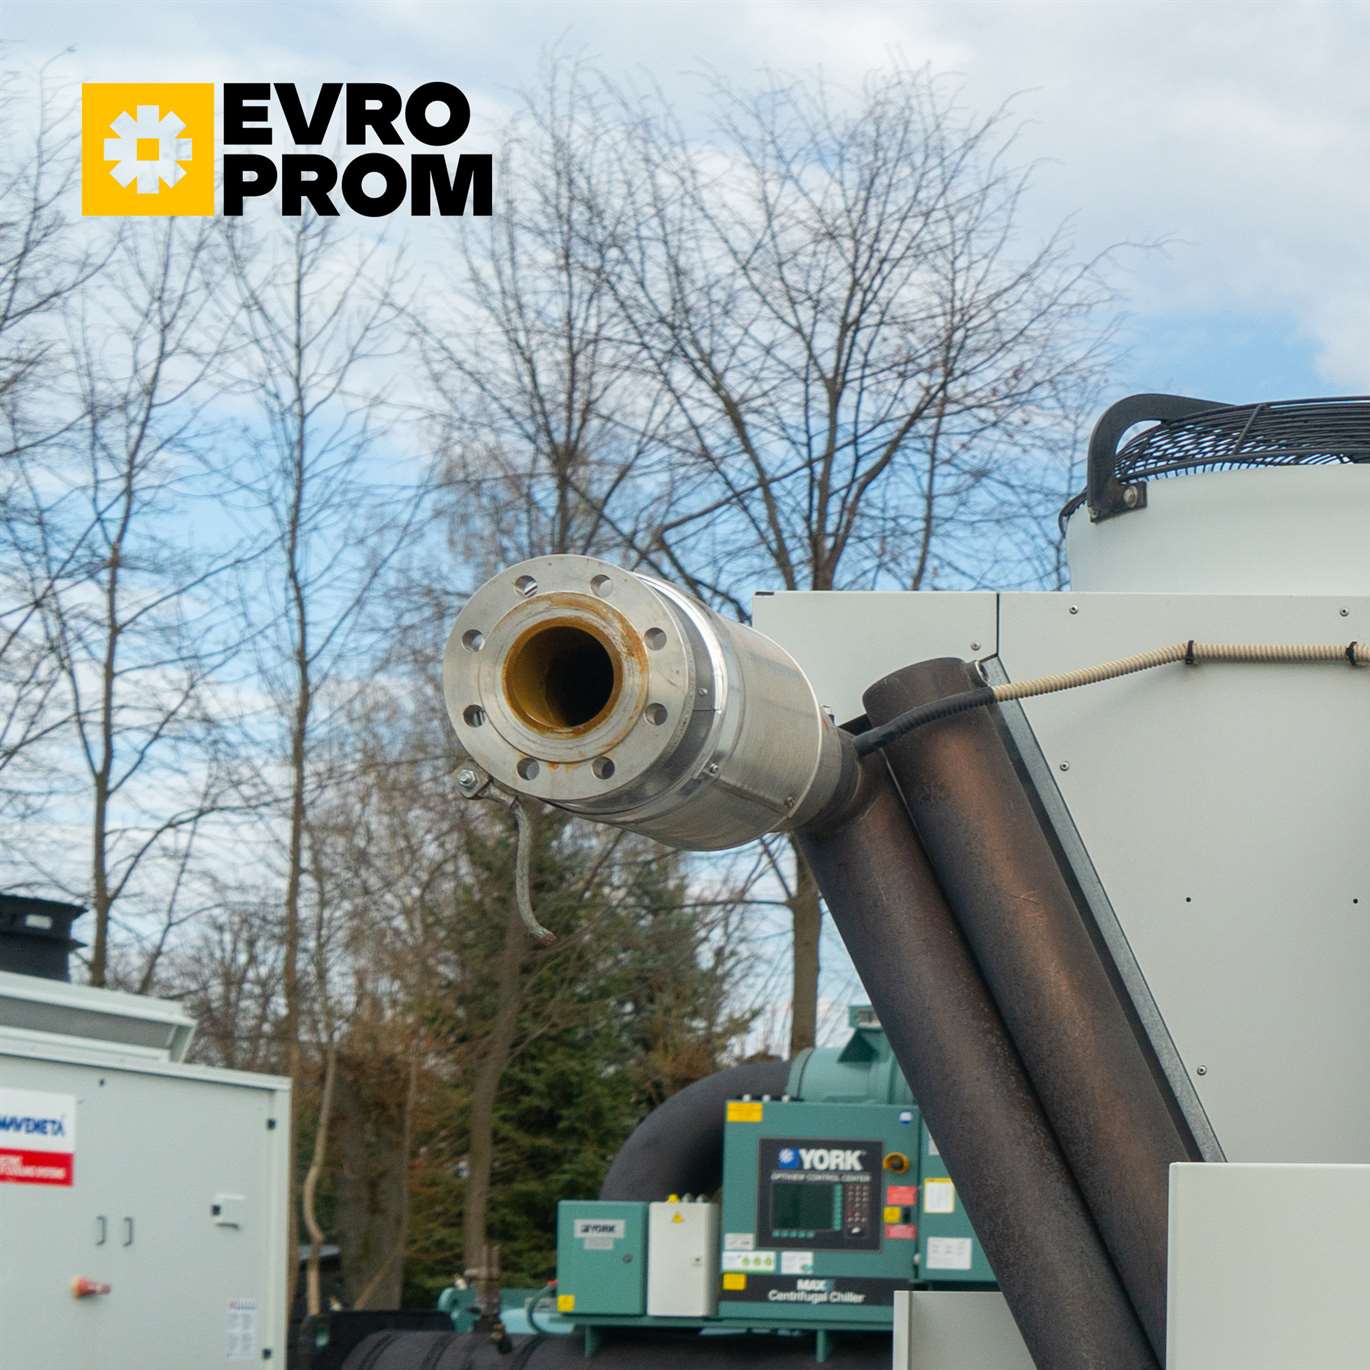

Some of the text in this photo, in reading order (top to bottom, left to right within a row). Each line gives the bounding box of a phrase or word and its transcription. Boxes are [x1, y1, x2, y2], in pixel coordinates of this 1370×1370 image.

[799, 1148, 864, 1171] YORK
[768, 1289, 865, 1304] Centrifugal Chiller
